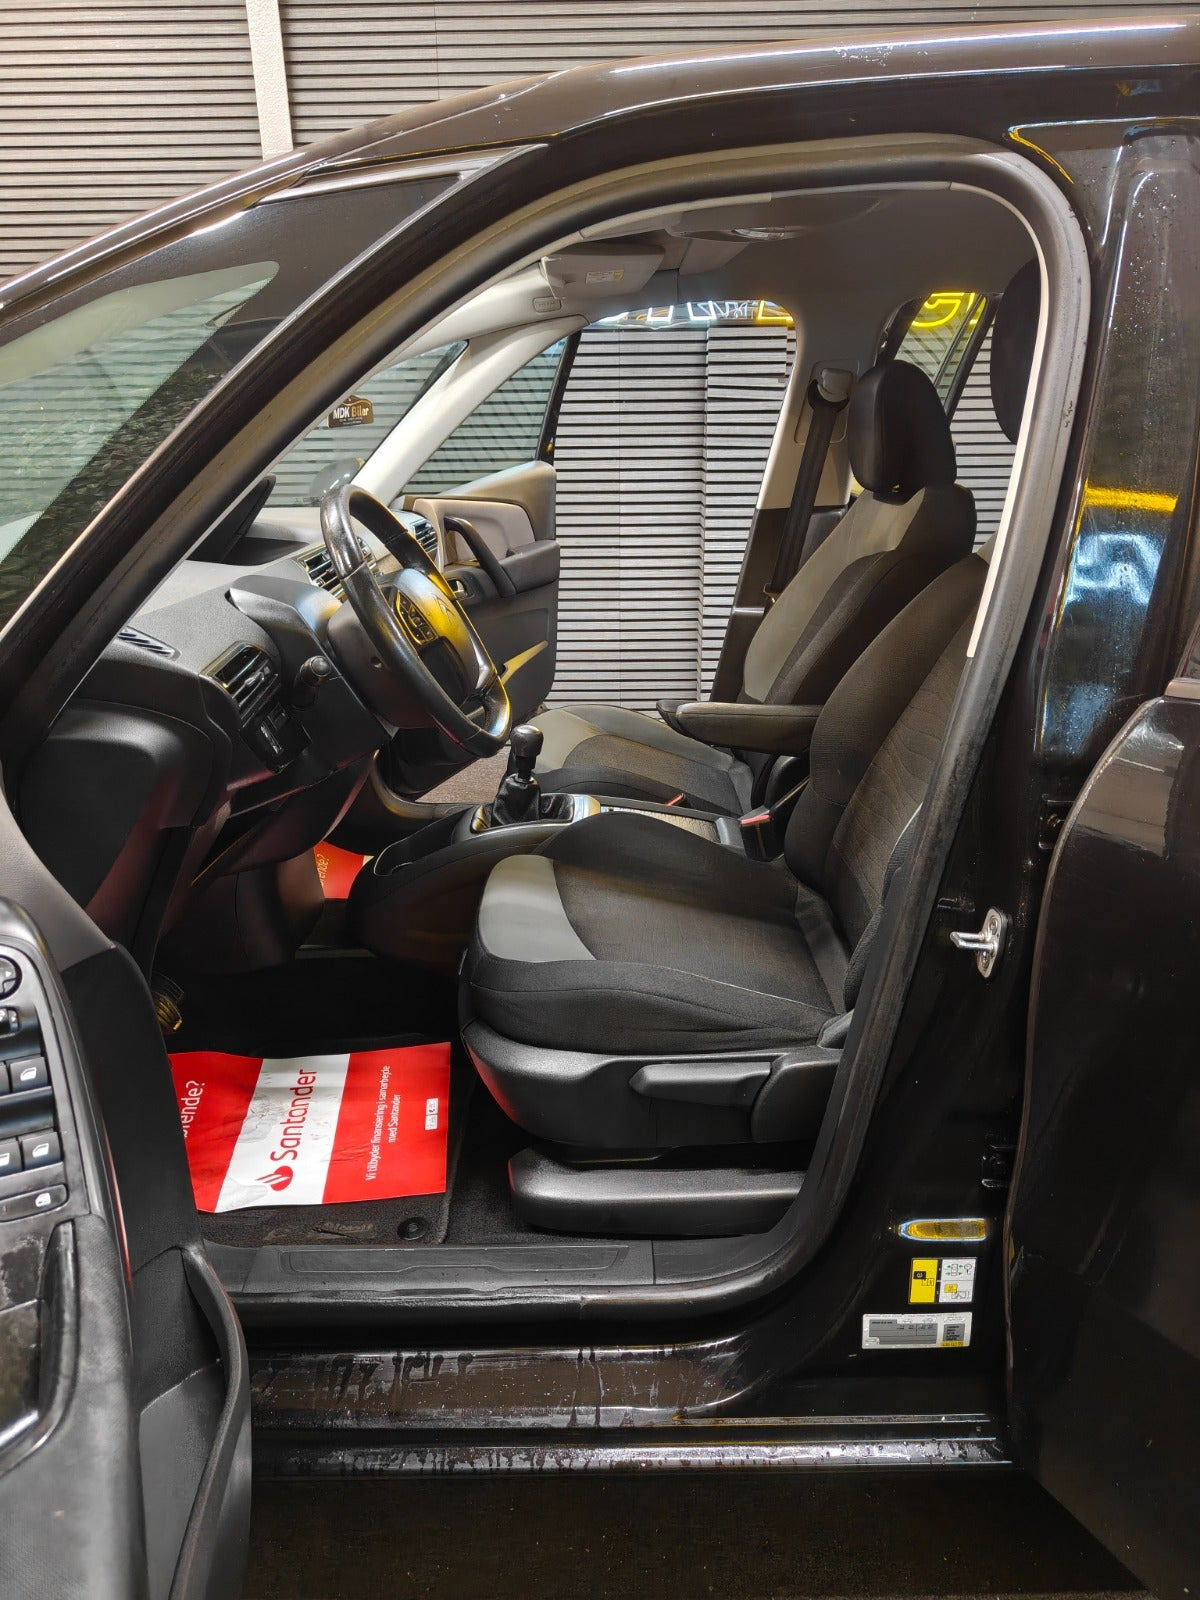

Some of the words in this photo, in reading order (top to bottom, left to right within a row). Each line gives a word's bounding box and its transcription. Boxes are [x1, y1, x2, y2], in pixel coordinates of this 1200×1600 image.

[333, 406, 350, 419] MDK
[379, 1065, 392, 1101] samarbejde
[270, 1069, 317, 1161] Santander
[370, 1104, 388, 1143] finansiering
[388, 1094, 401, 1127] Santander
[388, 1127, 398, 1143] med
[367, 1144, 381, 1172] tilbyder
[365, 1173, 377, 1181] Vi
